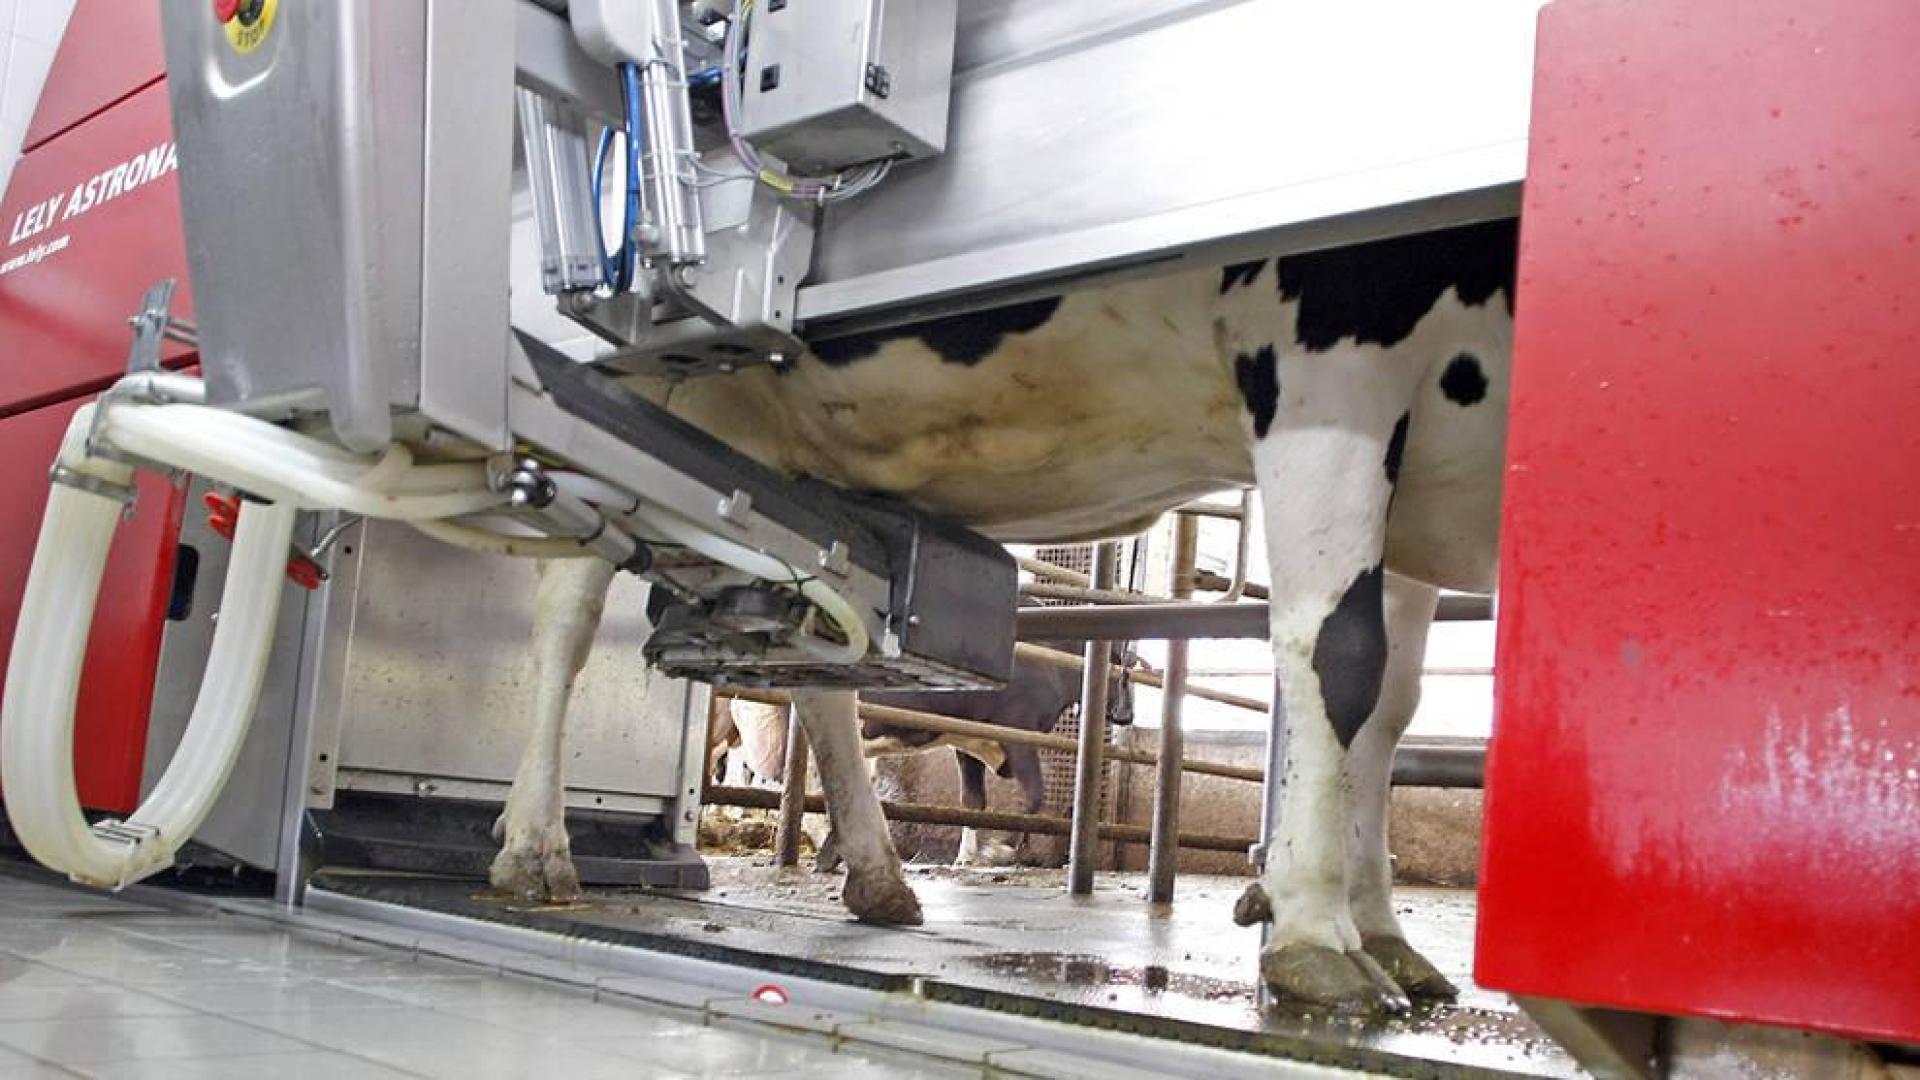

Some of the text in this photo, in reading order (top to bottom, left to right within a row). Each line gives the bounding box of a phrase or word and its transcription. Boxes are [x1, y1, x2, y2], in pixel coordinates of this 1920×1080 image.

[236, 18, 267, 48] STOP
[9, 142, 178, 246] LELY ASTRONA
